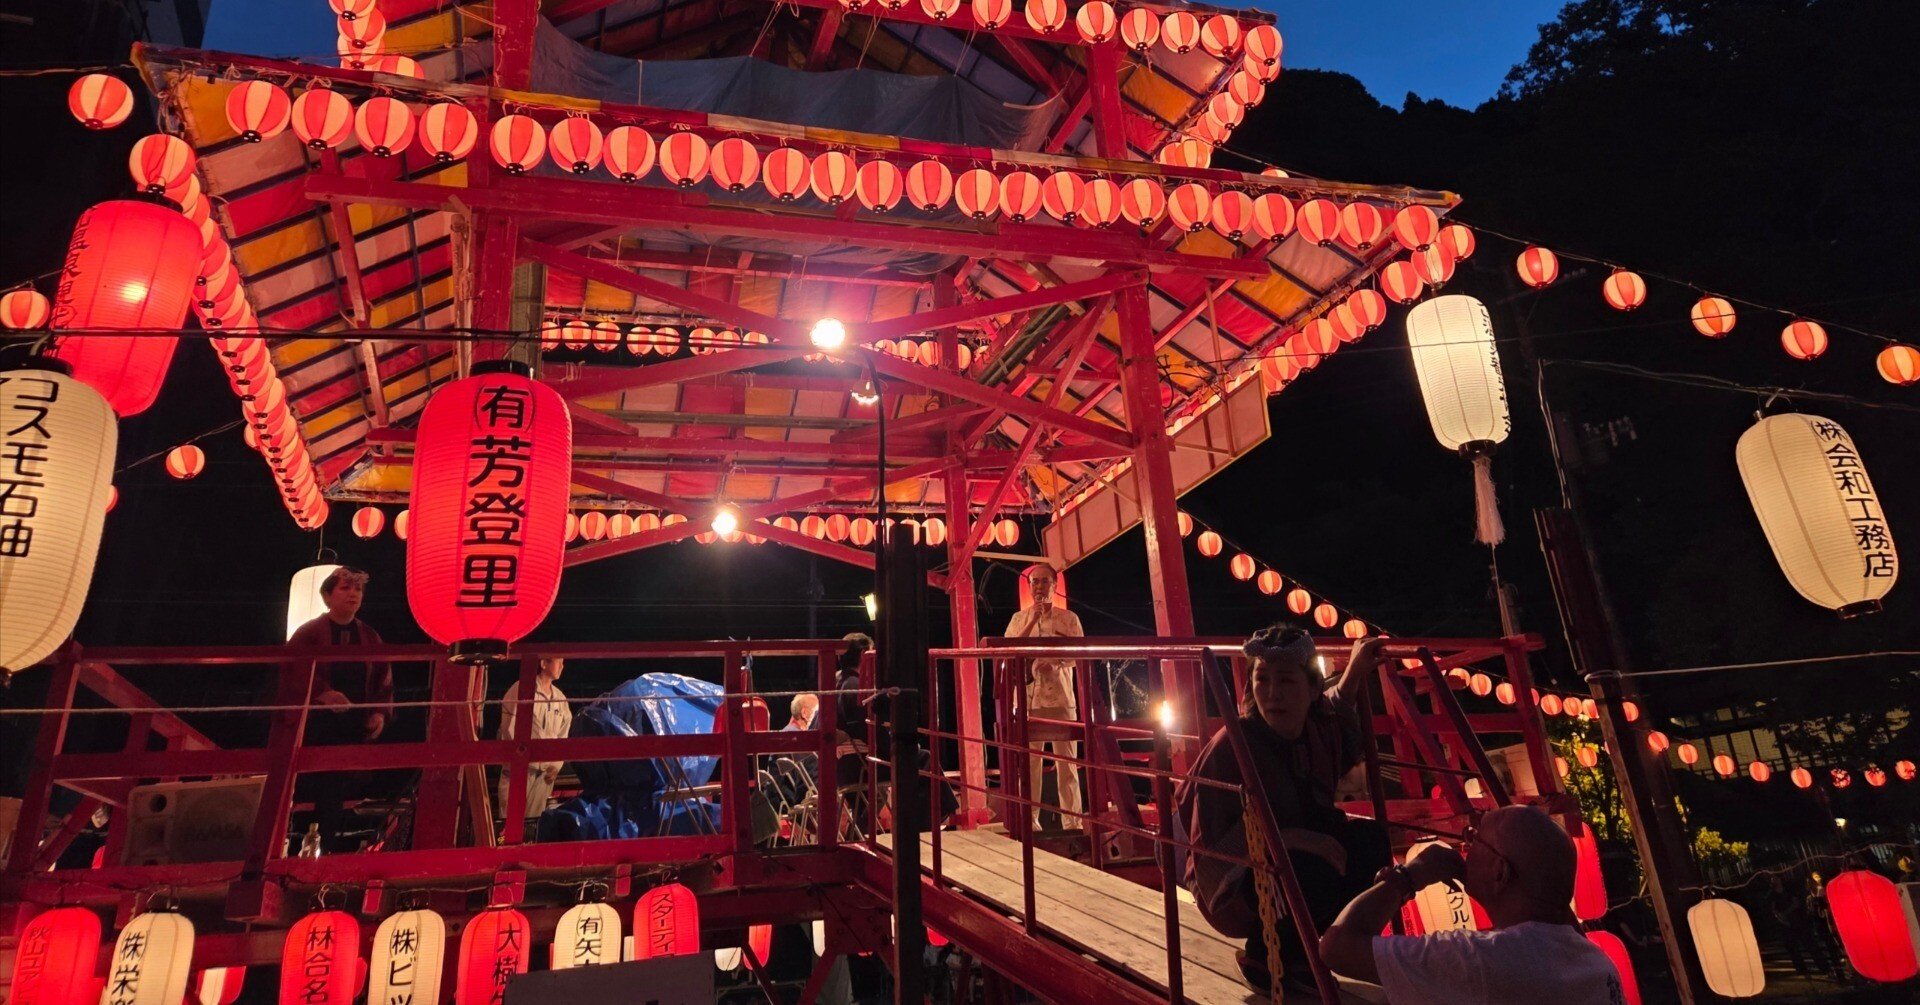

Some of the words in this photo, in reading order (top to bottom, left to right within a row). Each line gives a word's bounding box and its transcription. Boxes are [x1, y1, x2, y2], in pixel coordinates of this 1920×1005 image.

[574, 916, 604, 967] (有)矢
[651, 893, 676, 958] スターティ
[110, 929, 149, 1005] (株)栄
